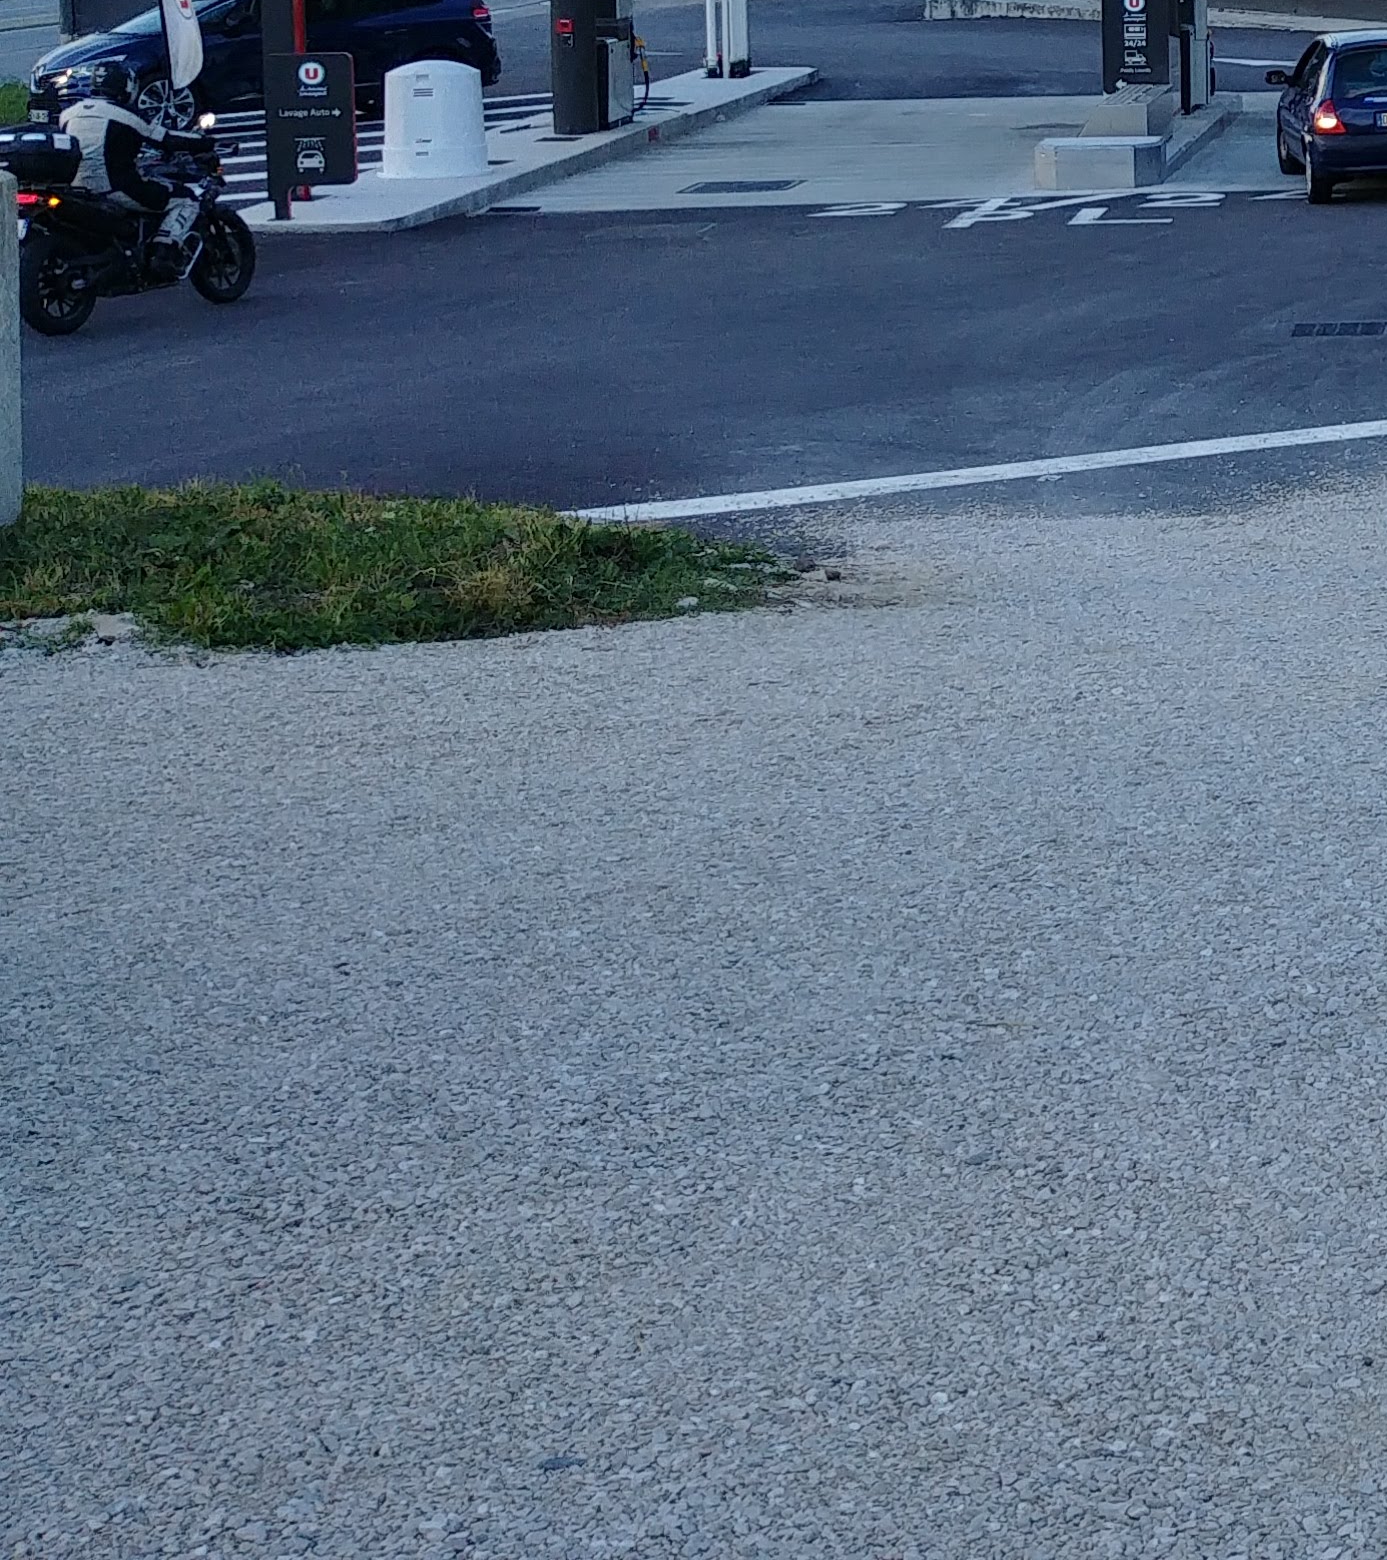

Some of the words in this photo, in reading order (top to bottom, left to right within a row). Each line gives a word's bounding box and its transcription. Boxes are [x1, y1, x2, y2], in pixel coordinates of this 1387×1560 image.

[1124, 40, 1146, 48] 24/24
[305, 68, 319, 80] U
[279, 108, 308, 118] Lavage
[310, 108, 330, 116] Auto
